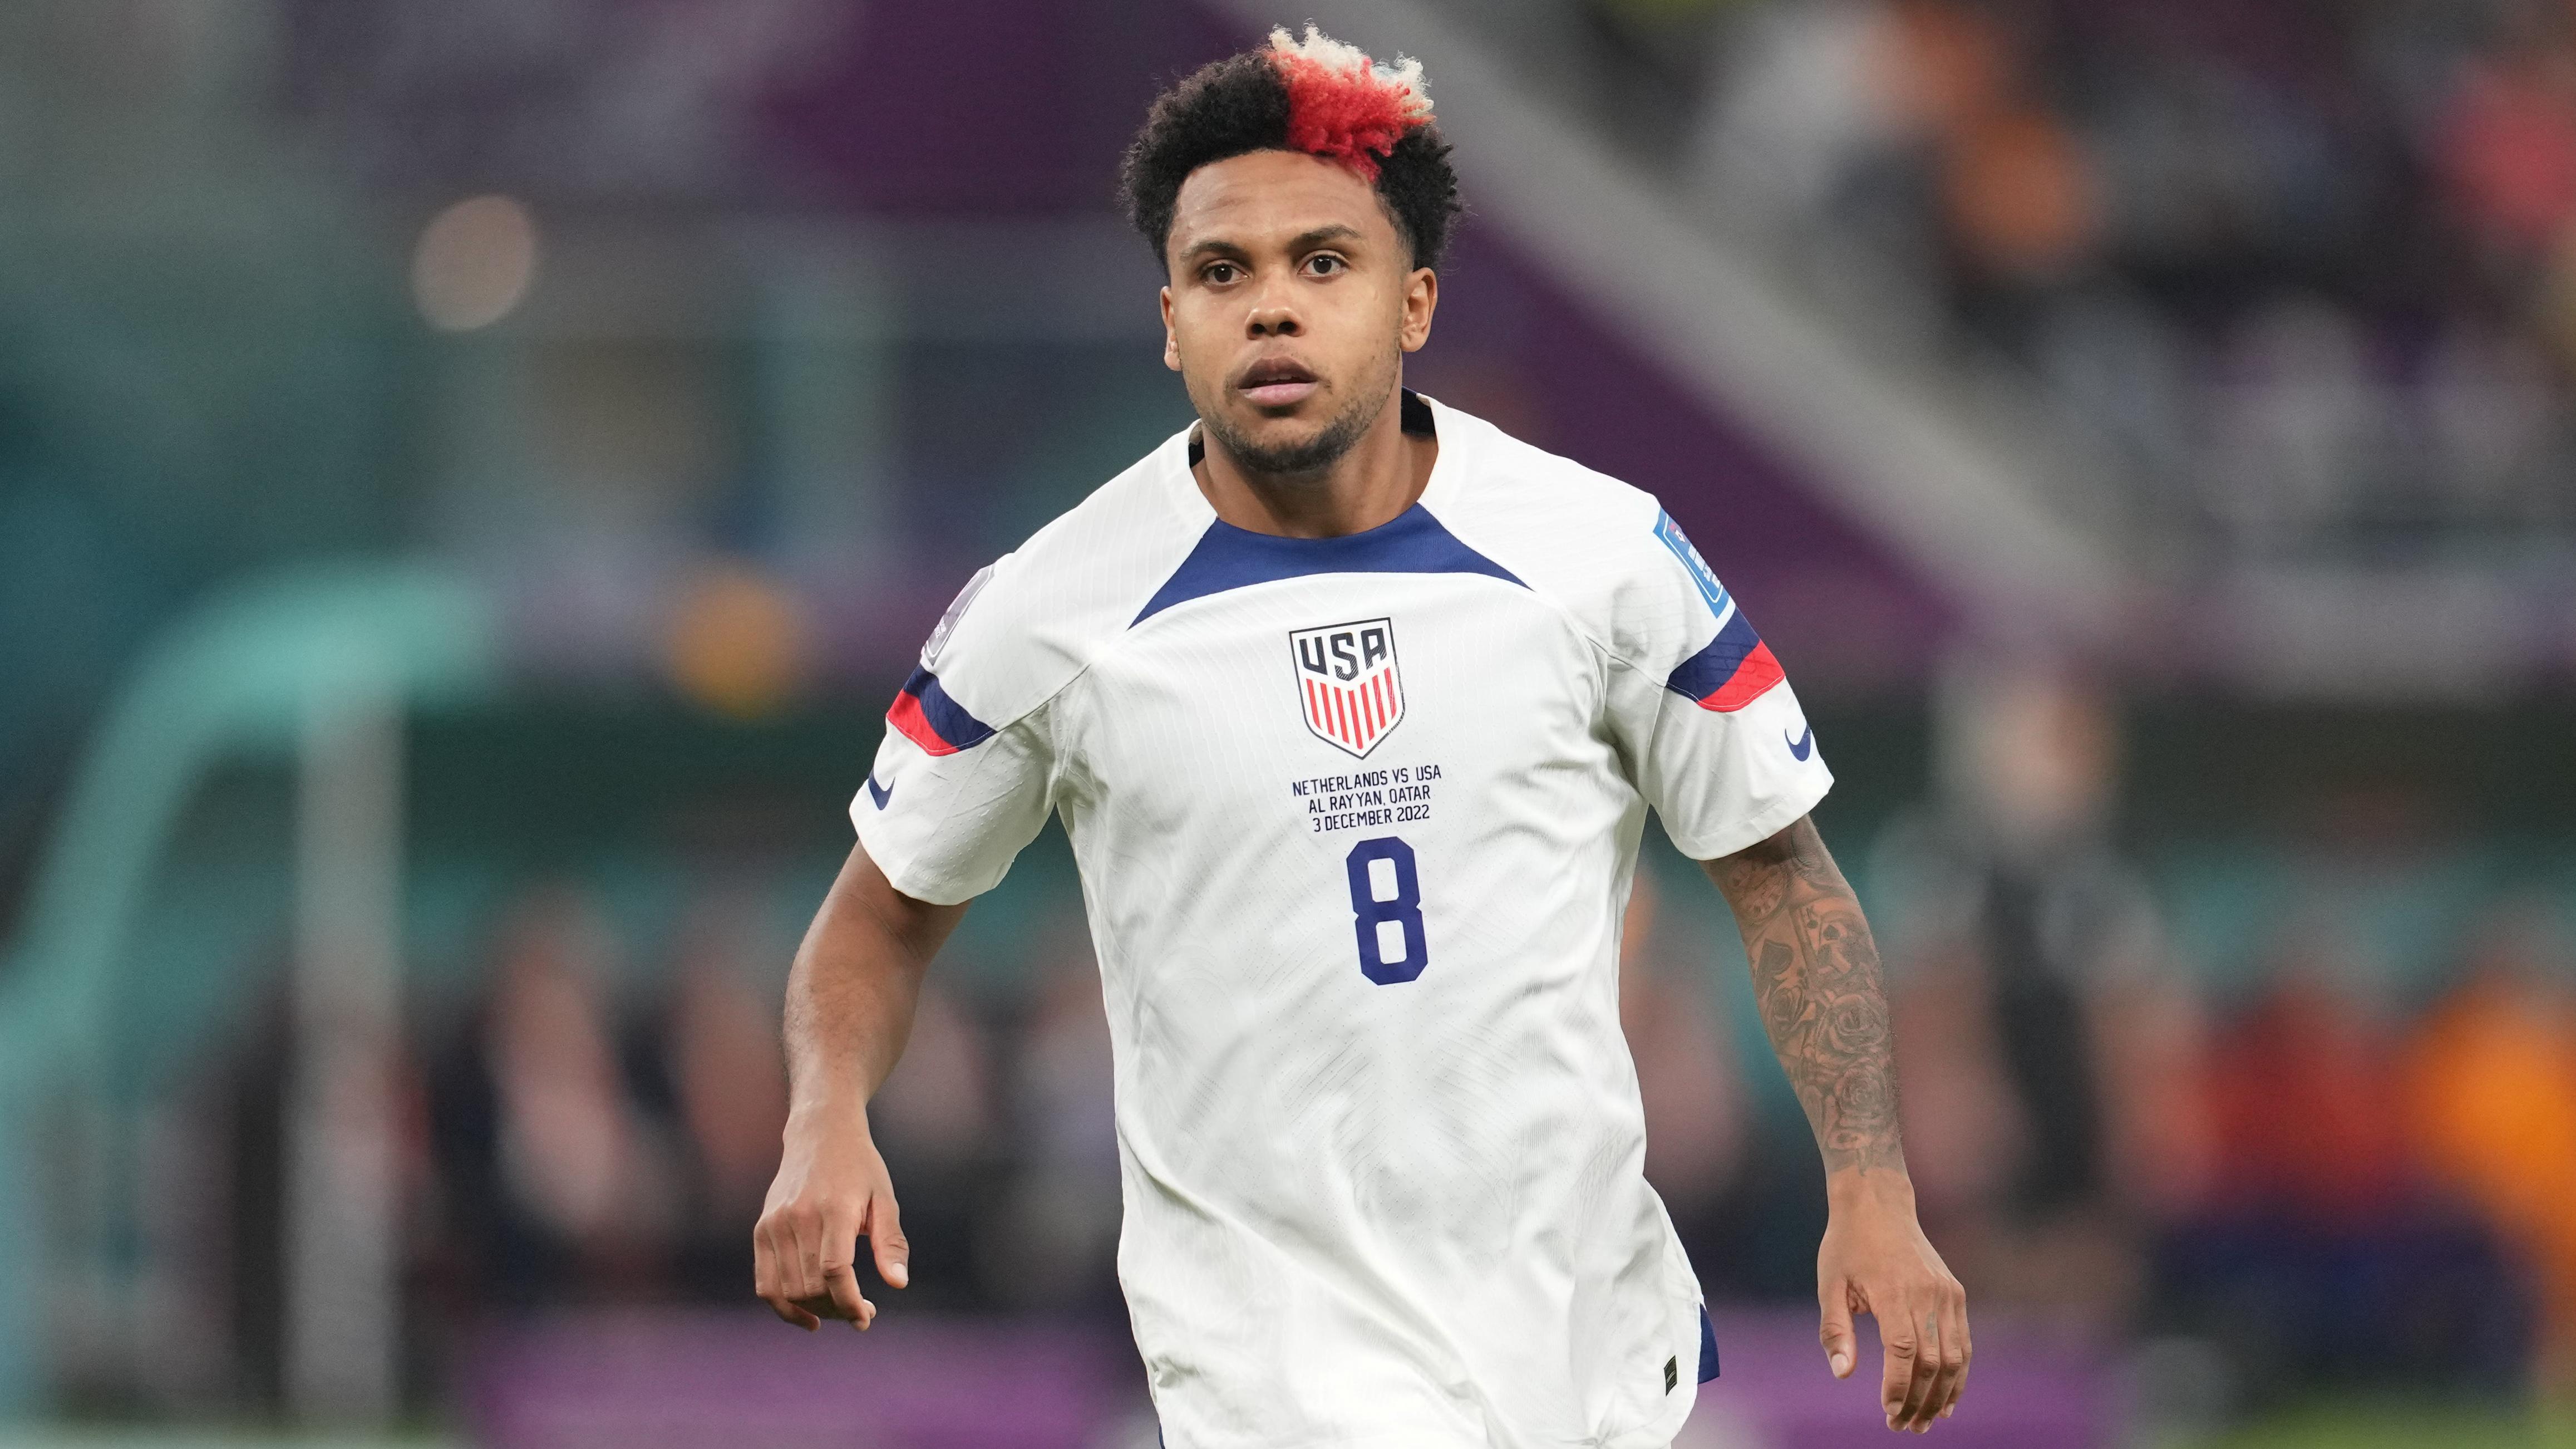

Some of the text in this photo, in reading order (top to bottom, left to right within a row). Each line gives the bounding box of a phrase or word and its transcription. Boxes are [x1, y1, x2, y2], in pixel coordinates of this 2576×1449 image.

[1299, 627, 1387, 682] USA
[1292, 764, 1441, 797] NETHERLANDS VS USA
[1309, 798, 1326, 814] AL
[1389, 785, 1431, 804] QATAR
[1313, 804, 1430, 832] 3 DECEMBER 2022
[1346, 836, 1429, 986] 8
